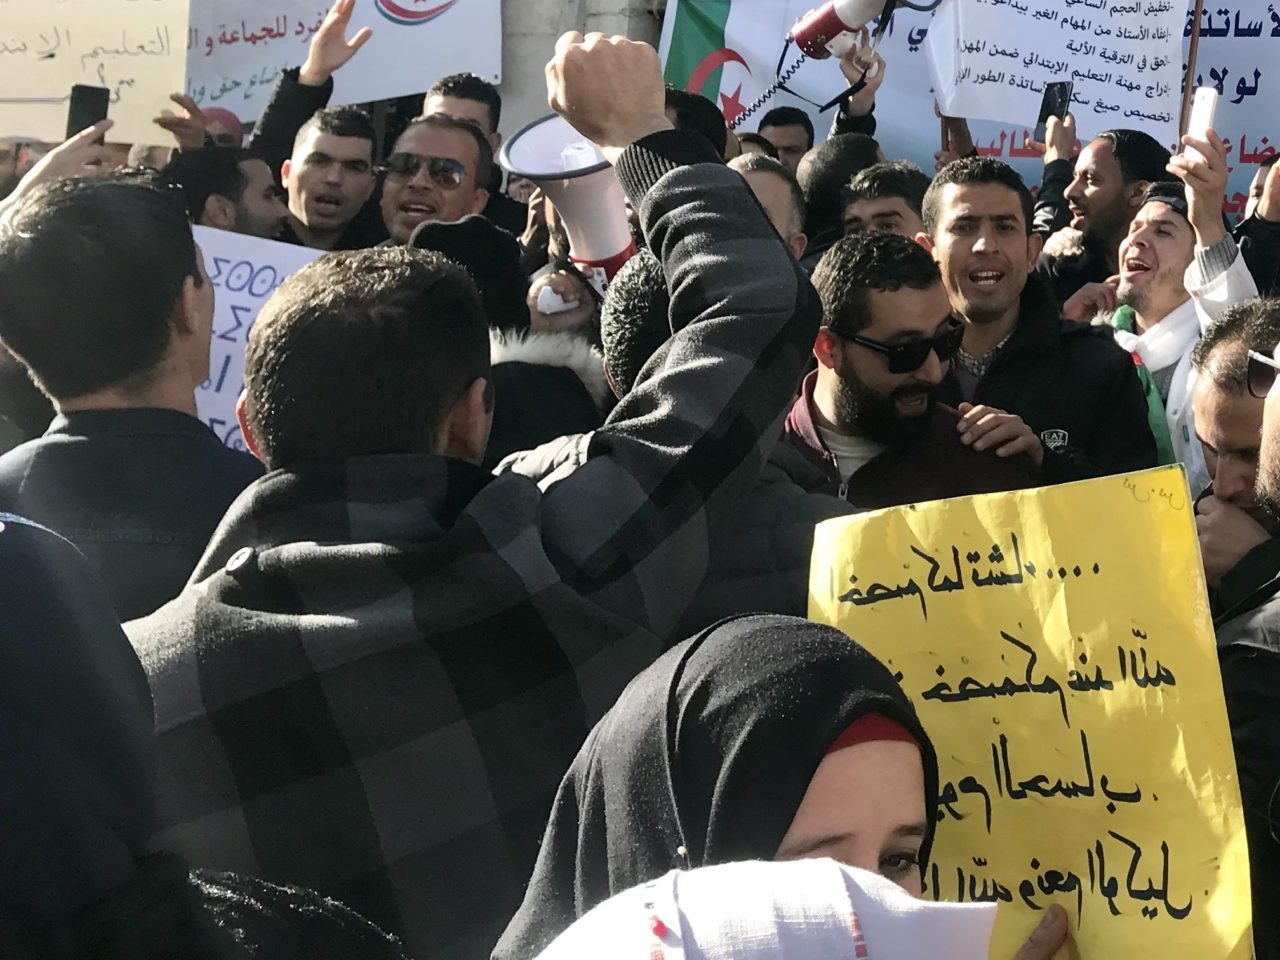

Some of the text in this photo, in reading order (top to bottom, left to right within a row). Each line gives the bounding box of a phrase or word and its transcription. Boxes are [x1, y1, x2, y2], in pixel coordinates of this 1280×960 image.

[1031, 8, 1058, 23] الغير
[1109, 2, 1141, 18] الحجم
[219, 15, 288, 46] للجماعة
[1060, 16, 1092, 31] المهام
[1094, 24, 1112, 37] من
[1116, 25, 1150, 41] الأستاذ
[205, 36, 214, 56] و
[988, 43, 1020, 59] ضمن
[1022, 51, 1069, 75] الإبتدائي
[1099, 49, 1134, 65] الترقية
[1137, 56, 1148, 73] في
[973, 70, 1005, 85] الطور
[1071, 67, 1112, 84] التعليم
[1116, 74, 1142, 91] مهنة
[1093, 98, 1120, 113] صيغ
[1045, 432, 1064, 440] EA7
